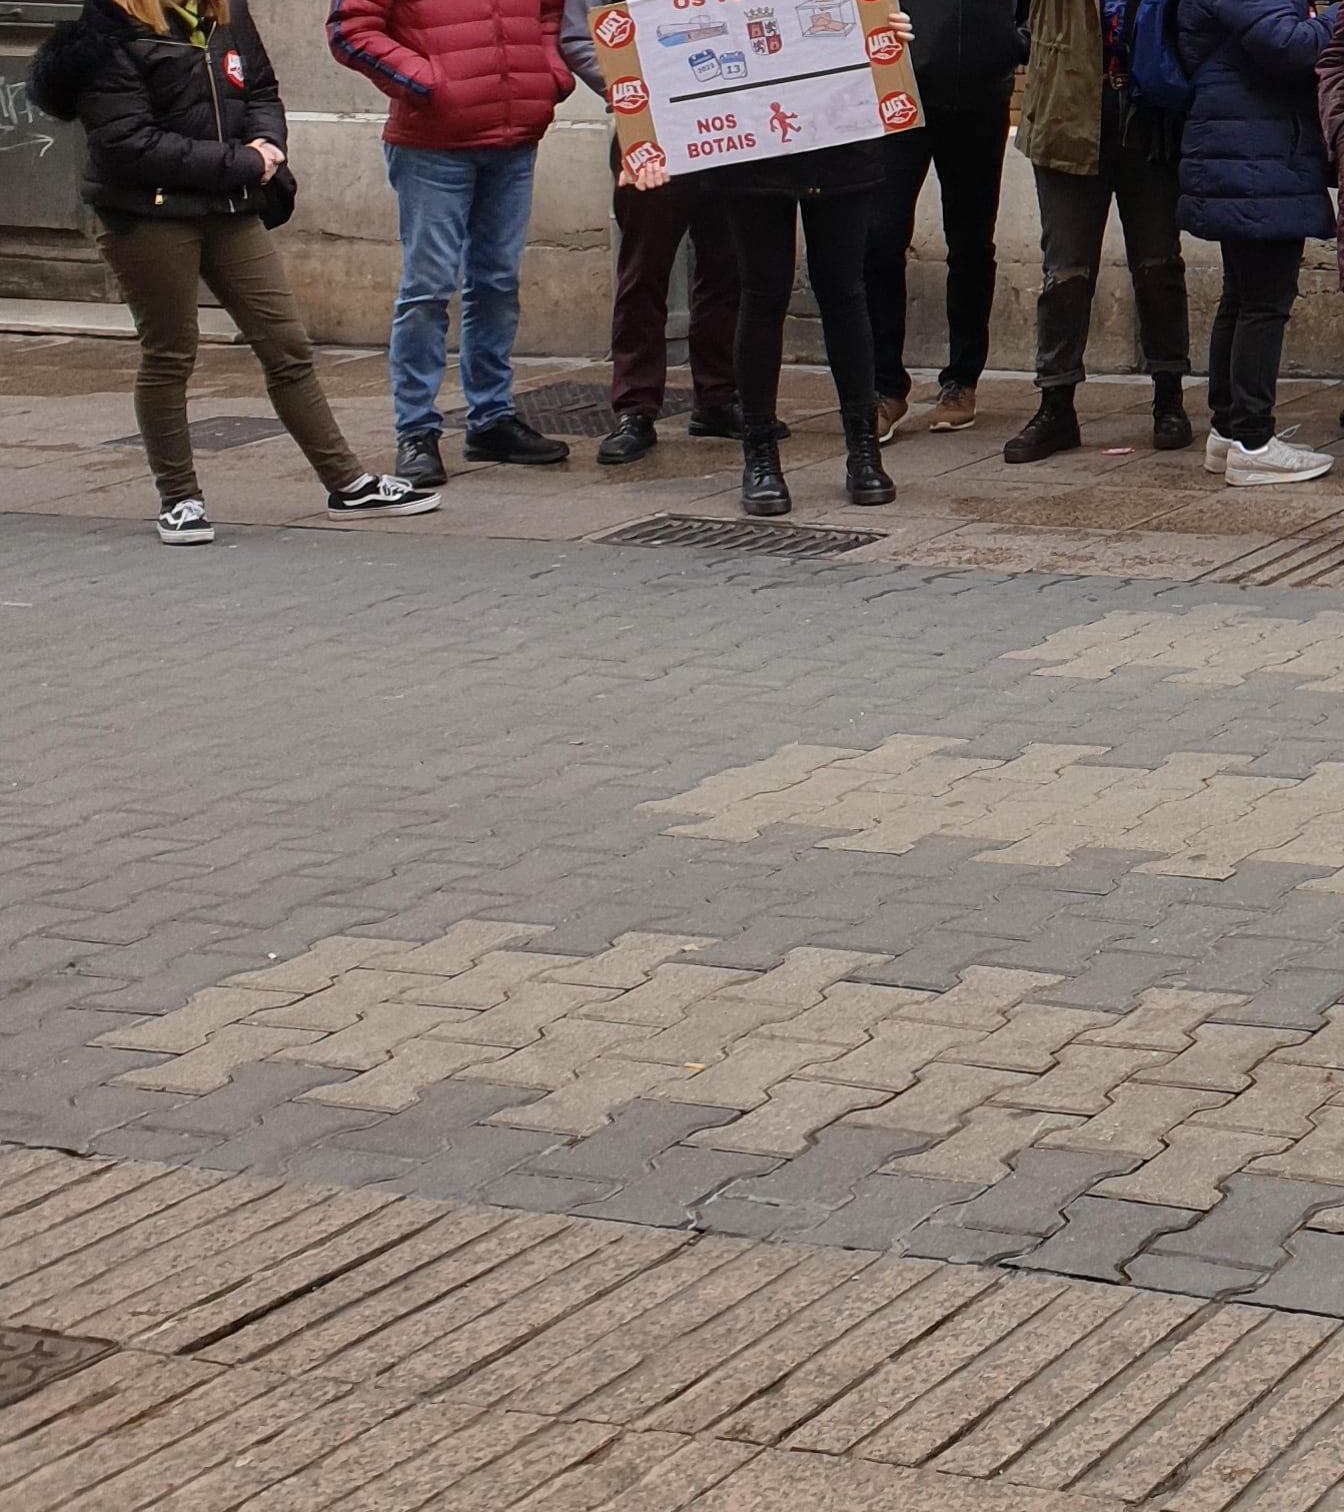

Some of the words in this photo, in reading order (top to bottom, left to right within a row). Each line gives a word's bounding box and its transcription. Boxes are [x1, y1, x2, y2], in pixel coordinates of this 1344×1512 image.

[727, 64, 741, 74] 13
[696, 114, 738, 134] NOS
[687, 133, 757, 159] BOTAIS
